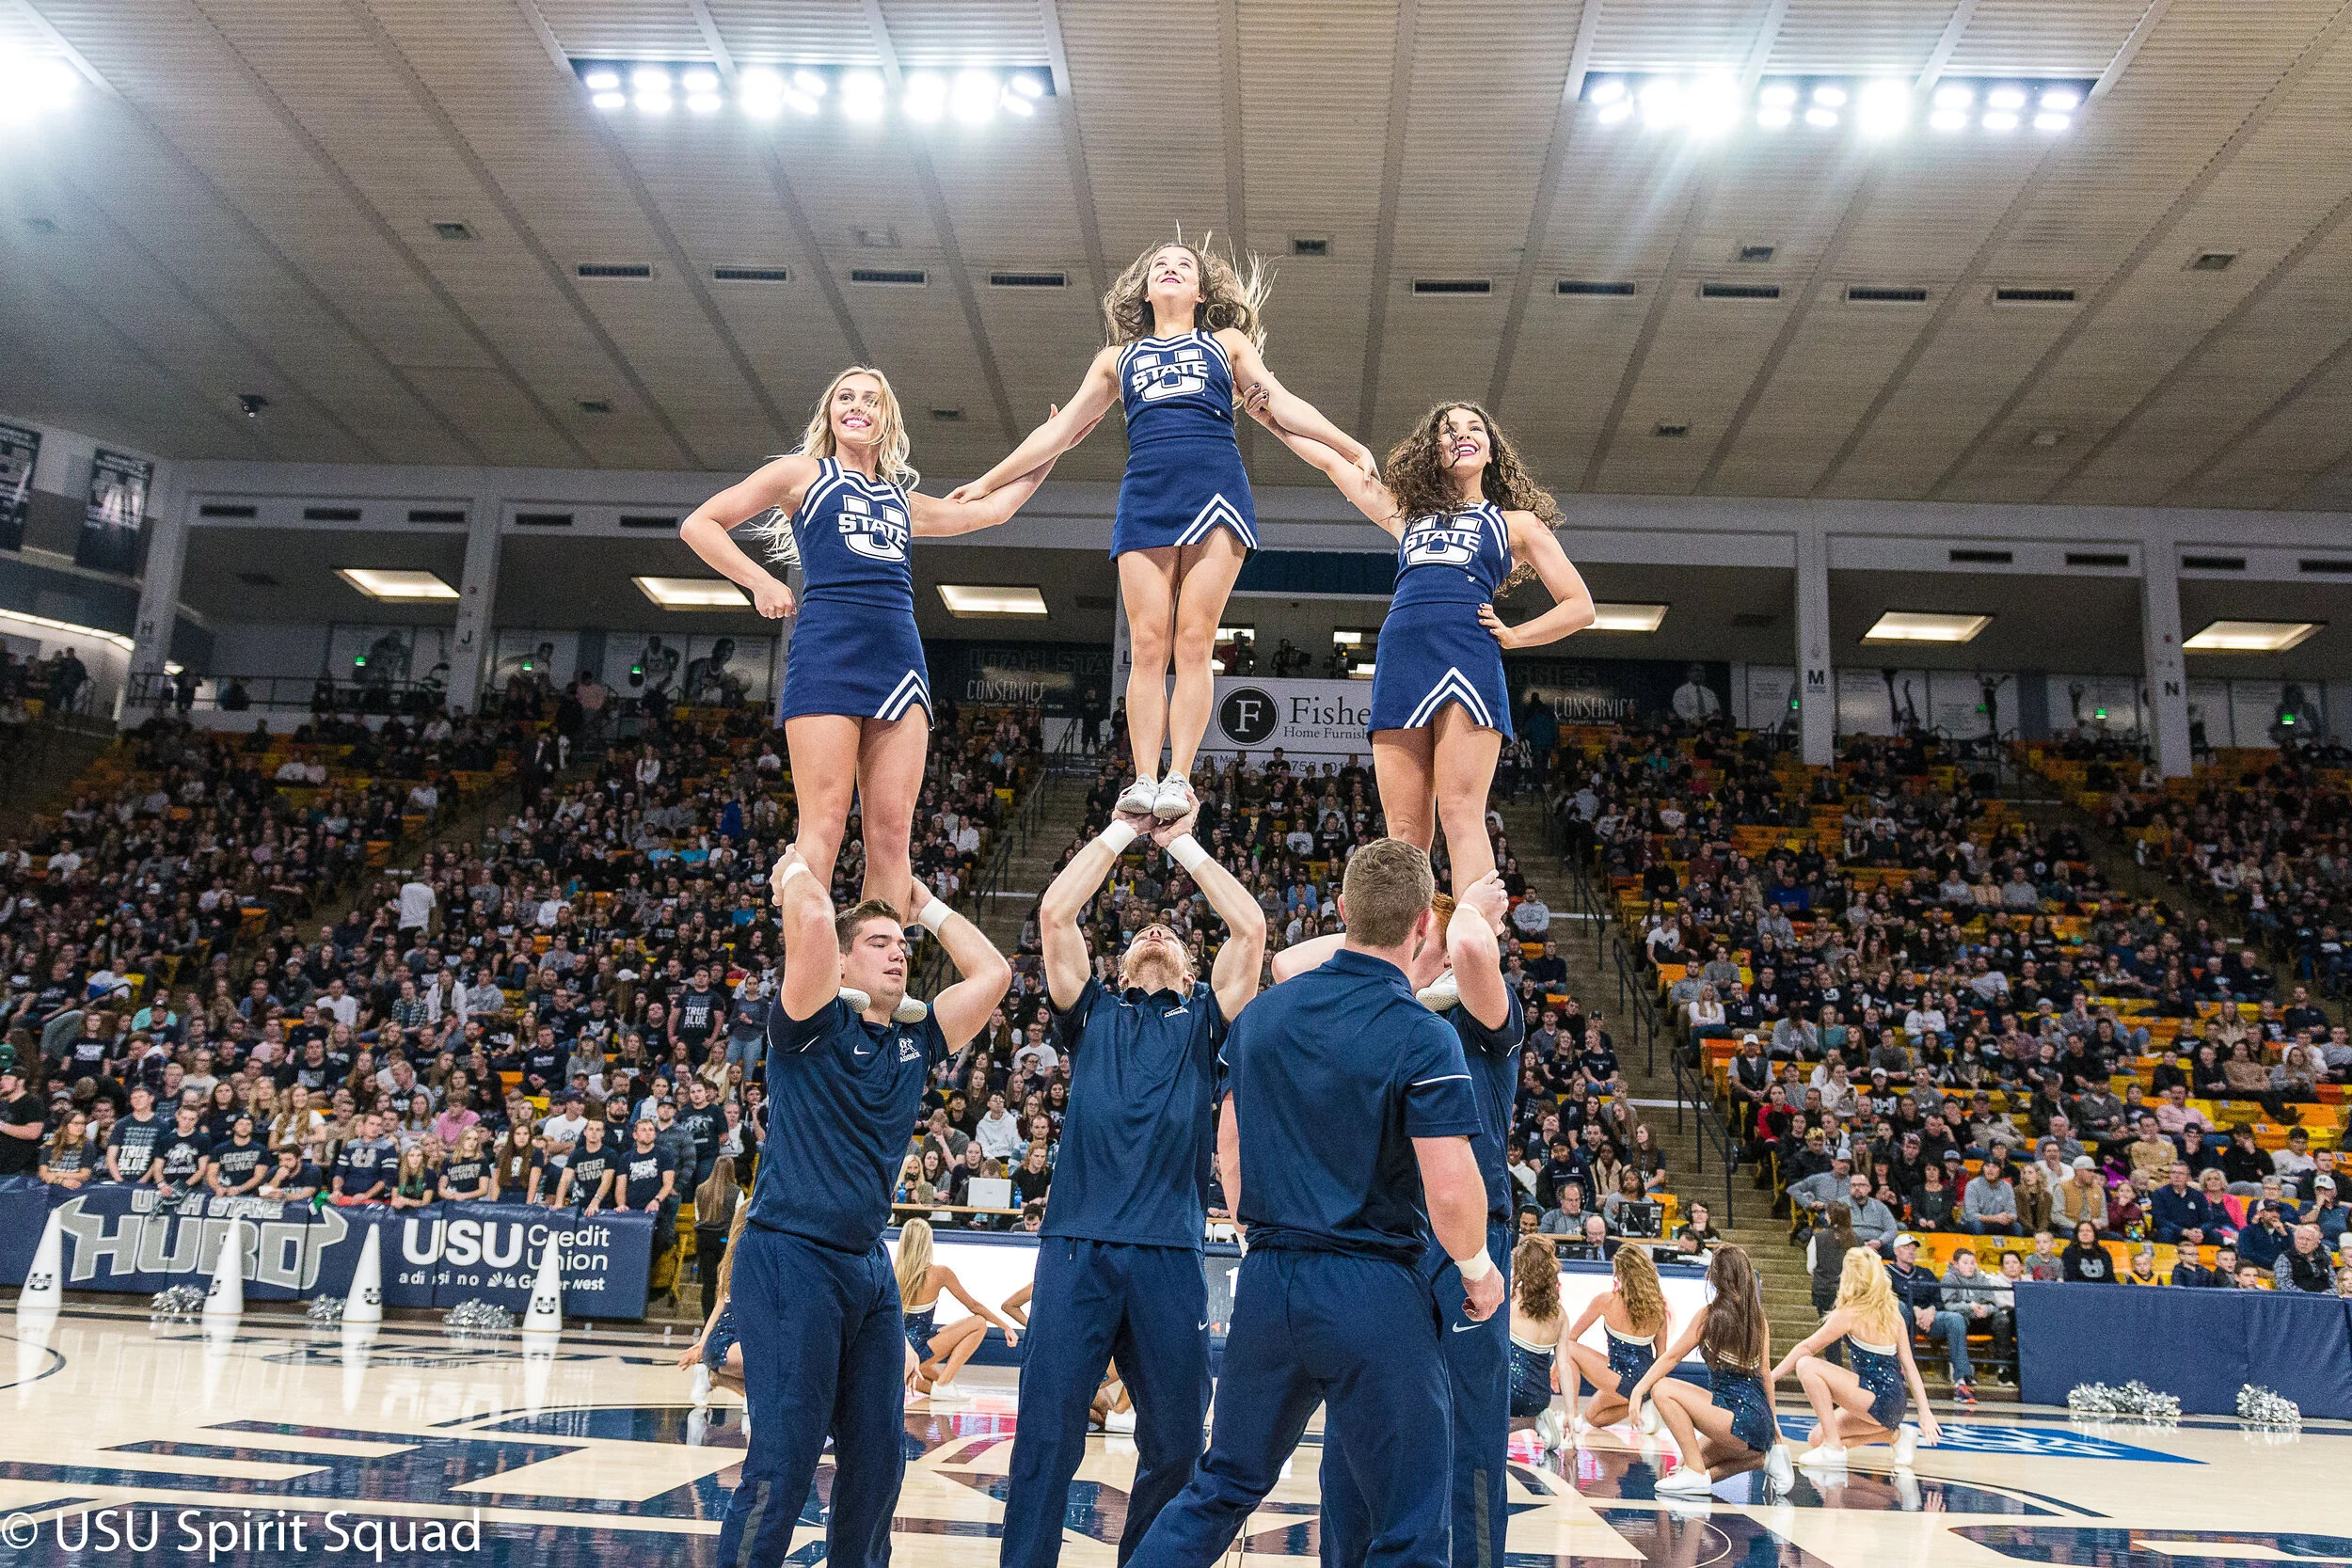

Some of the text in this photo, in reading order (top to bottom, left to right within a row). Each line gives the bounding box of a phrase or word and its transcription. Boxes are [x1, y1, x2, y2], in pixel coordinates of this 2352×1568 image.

[1132, 360, 1209, 393] STATE
[838, 513, 908, 550] STATE
[1404, 530, 1483, 555] STATE
[1807, 669, 1825, 685] M
[2165, 681, 2180, 696] N
[1234, 699, 1263, 733] F
[1289, 695, 1371, 726] Fishe
[1283, 726, 1367, 739] Home Furnish
[684, 1015, 708, 1026] BLUE
[685, 1006, 710, 1016] TRUE
[120, 1145, 154, 1159] TRUE
[118, 1158, 150, 1171] BLUE
[402, 1218, 524, 1268] USU
[528, 1224, 612, 1247] Cedit
